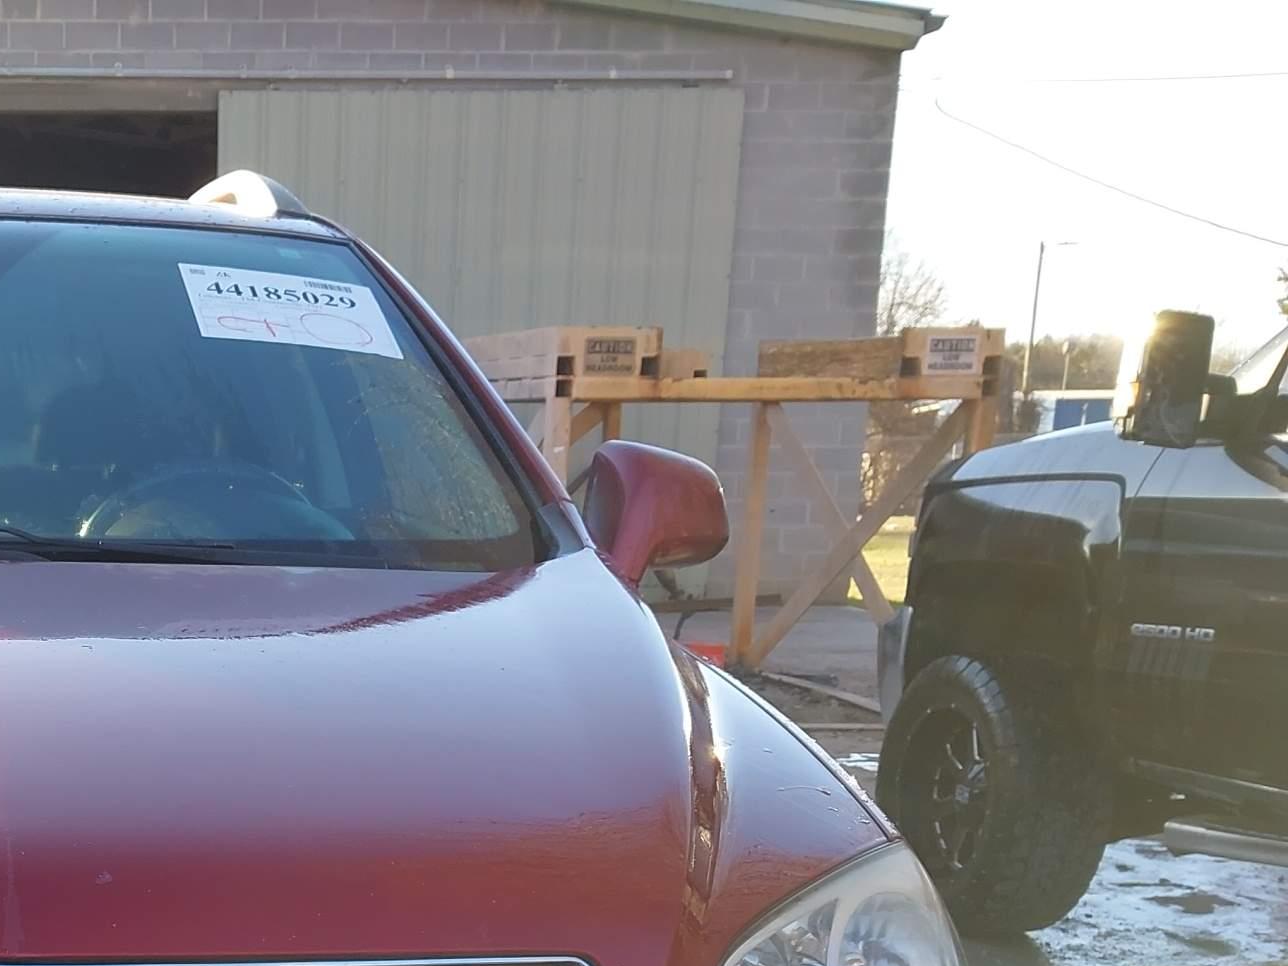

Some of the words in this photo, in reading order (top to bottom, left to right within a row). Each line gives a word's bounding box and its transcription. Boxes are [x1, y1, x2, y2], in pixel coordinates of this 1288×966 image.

[206, 281, 357, 309] 44185029
[588, 341, 633, 353] CAUTION
[931, 339, 975, 351] CAUTION
[600, 355, 617, 363] LOW
[1131, 623, 1181, 639] 2500
[1185, 627, 1215, 641] HD
